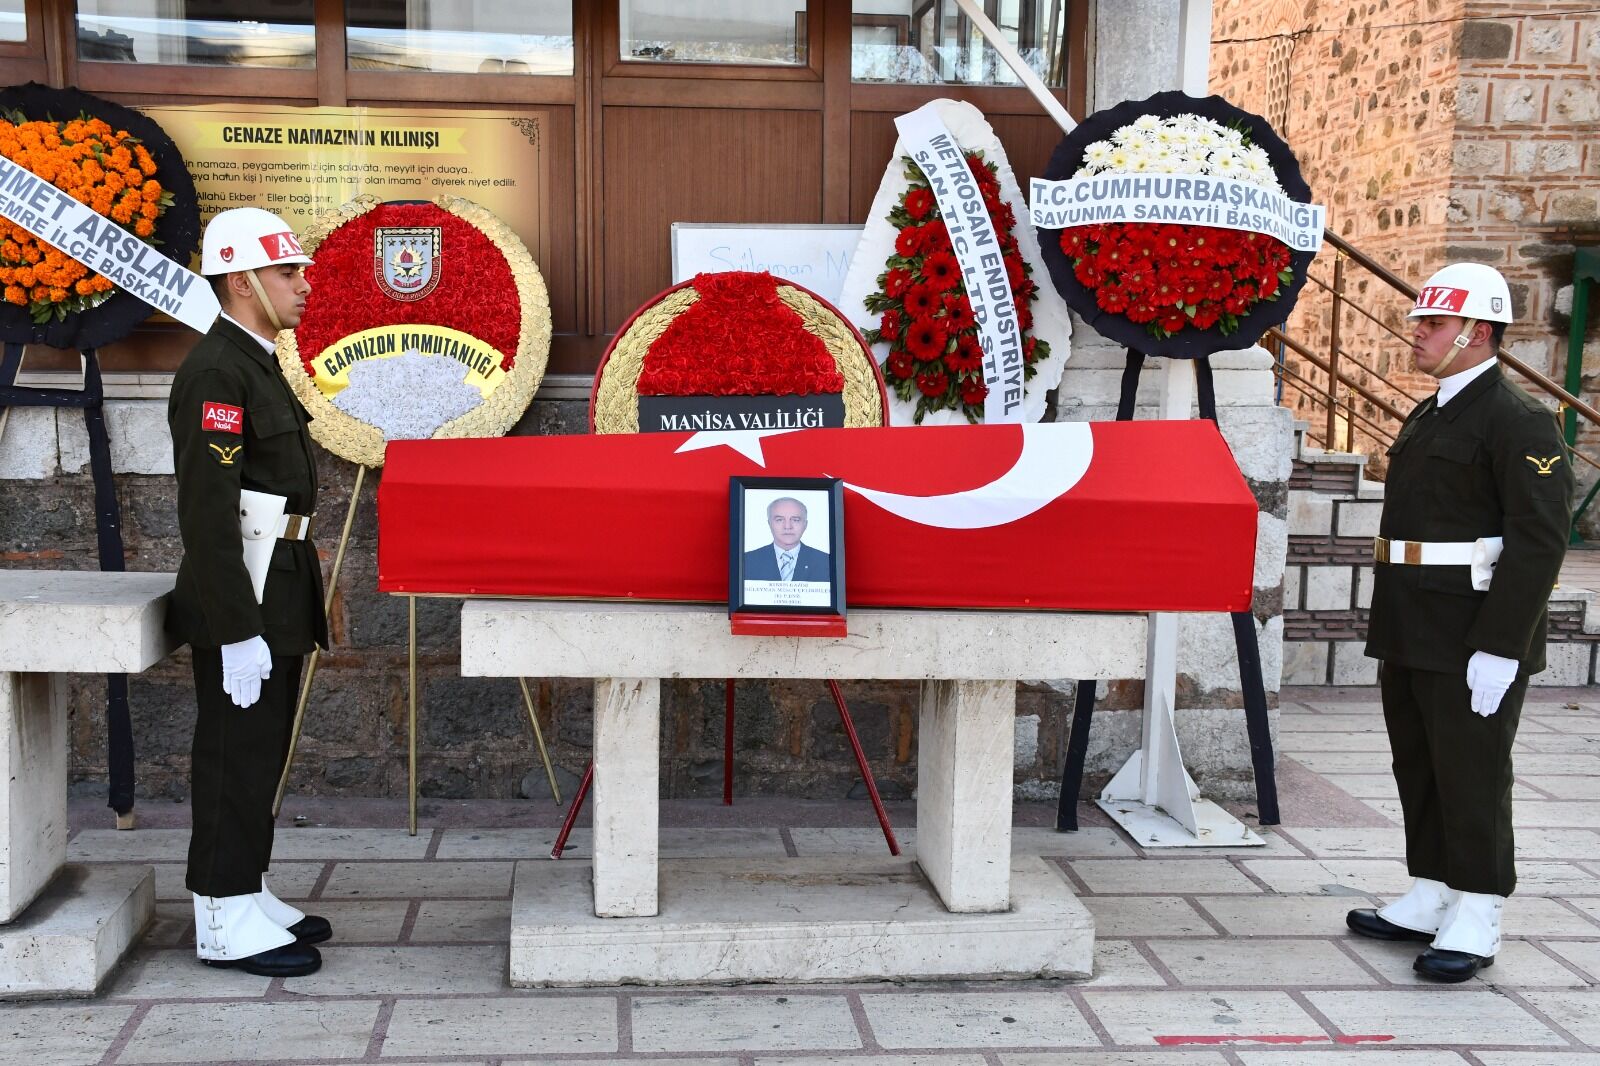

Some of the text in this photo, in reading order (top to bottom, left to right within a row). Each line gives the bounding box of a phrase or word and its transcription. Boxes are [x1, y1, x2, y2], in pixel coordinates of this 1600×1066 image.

[223, 126, 440, 149] CENAZE NAMAZININ KILINIŞI
[242, 161, 318, 172] peygamberimiz
[319, 162, 336, 173] için
[384, 164, 415, 175] meyyit
[417, 164, 434, 175] için
[243, 173, 257, 184] kişi
[265, 174, 303, 184] niyetine
[305, 174, 338, 184] uydum
[364, 175, 386, 185] olan
[431, 176, 466, 188] diyerek
[468, 177, 491, 188] niyet
[196, 191, 226, 201] Allahü
[229, 192, 256, 202] Ekber
[267, 193, 287, 202] Eller
[293, 207, 305, 216] ve
[0, 160, 195, 298] HMET ARSLAN
[1033, 204, 1317, 249] SAVUNMA SANAYİİ BAŞKANLIĞI
[0, 194, 183, 315] EMRE İLÇE BAŞKANI
[929, 133, 1024, 416] METROSAN ENDÜSTRİYEL
[323, 333, 497, 380] GARNİZON KOMUTANLIĞI
[660, 407, 825, 431] MANİSA VALİLİĞİ
